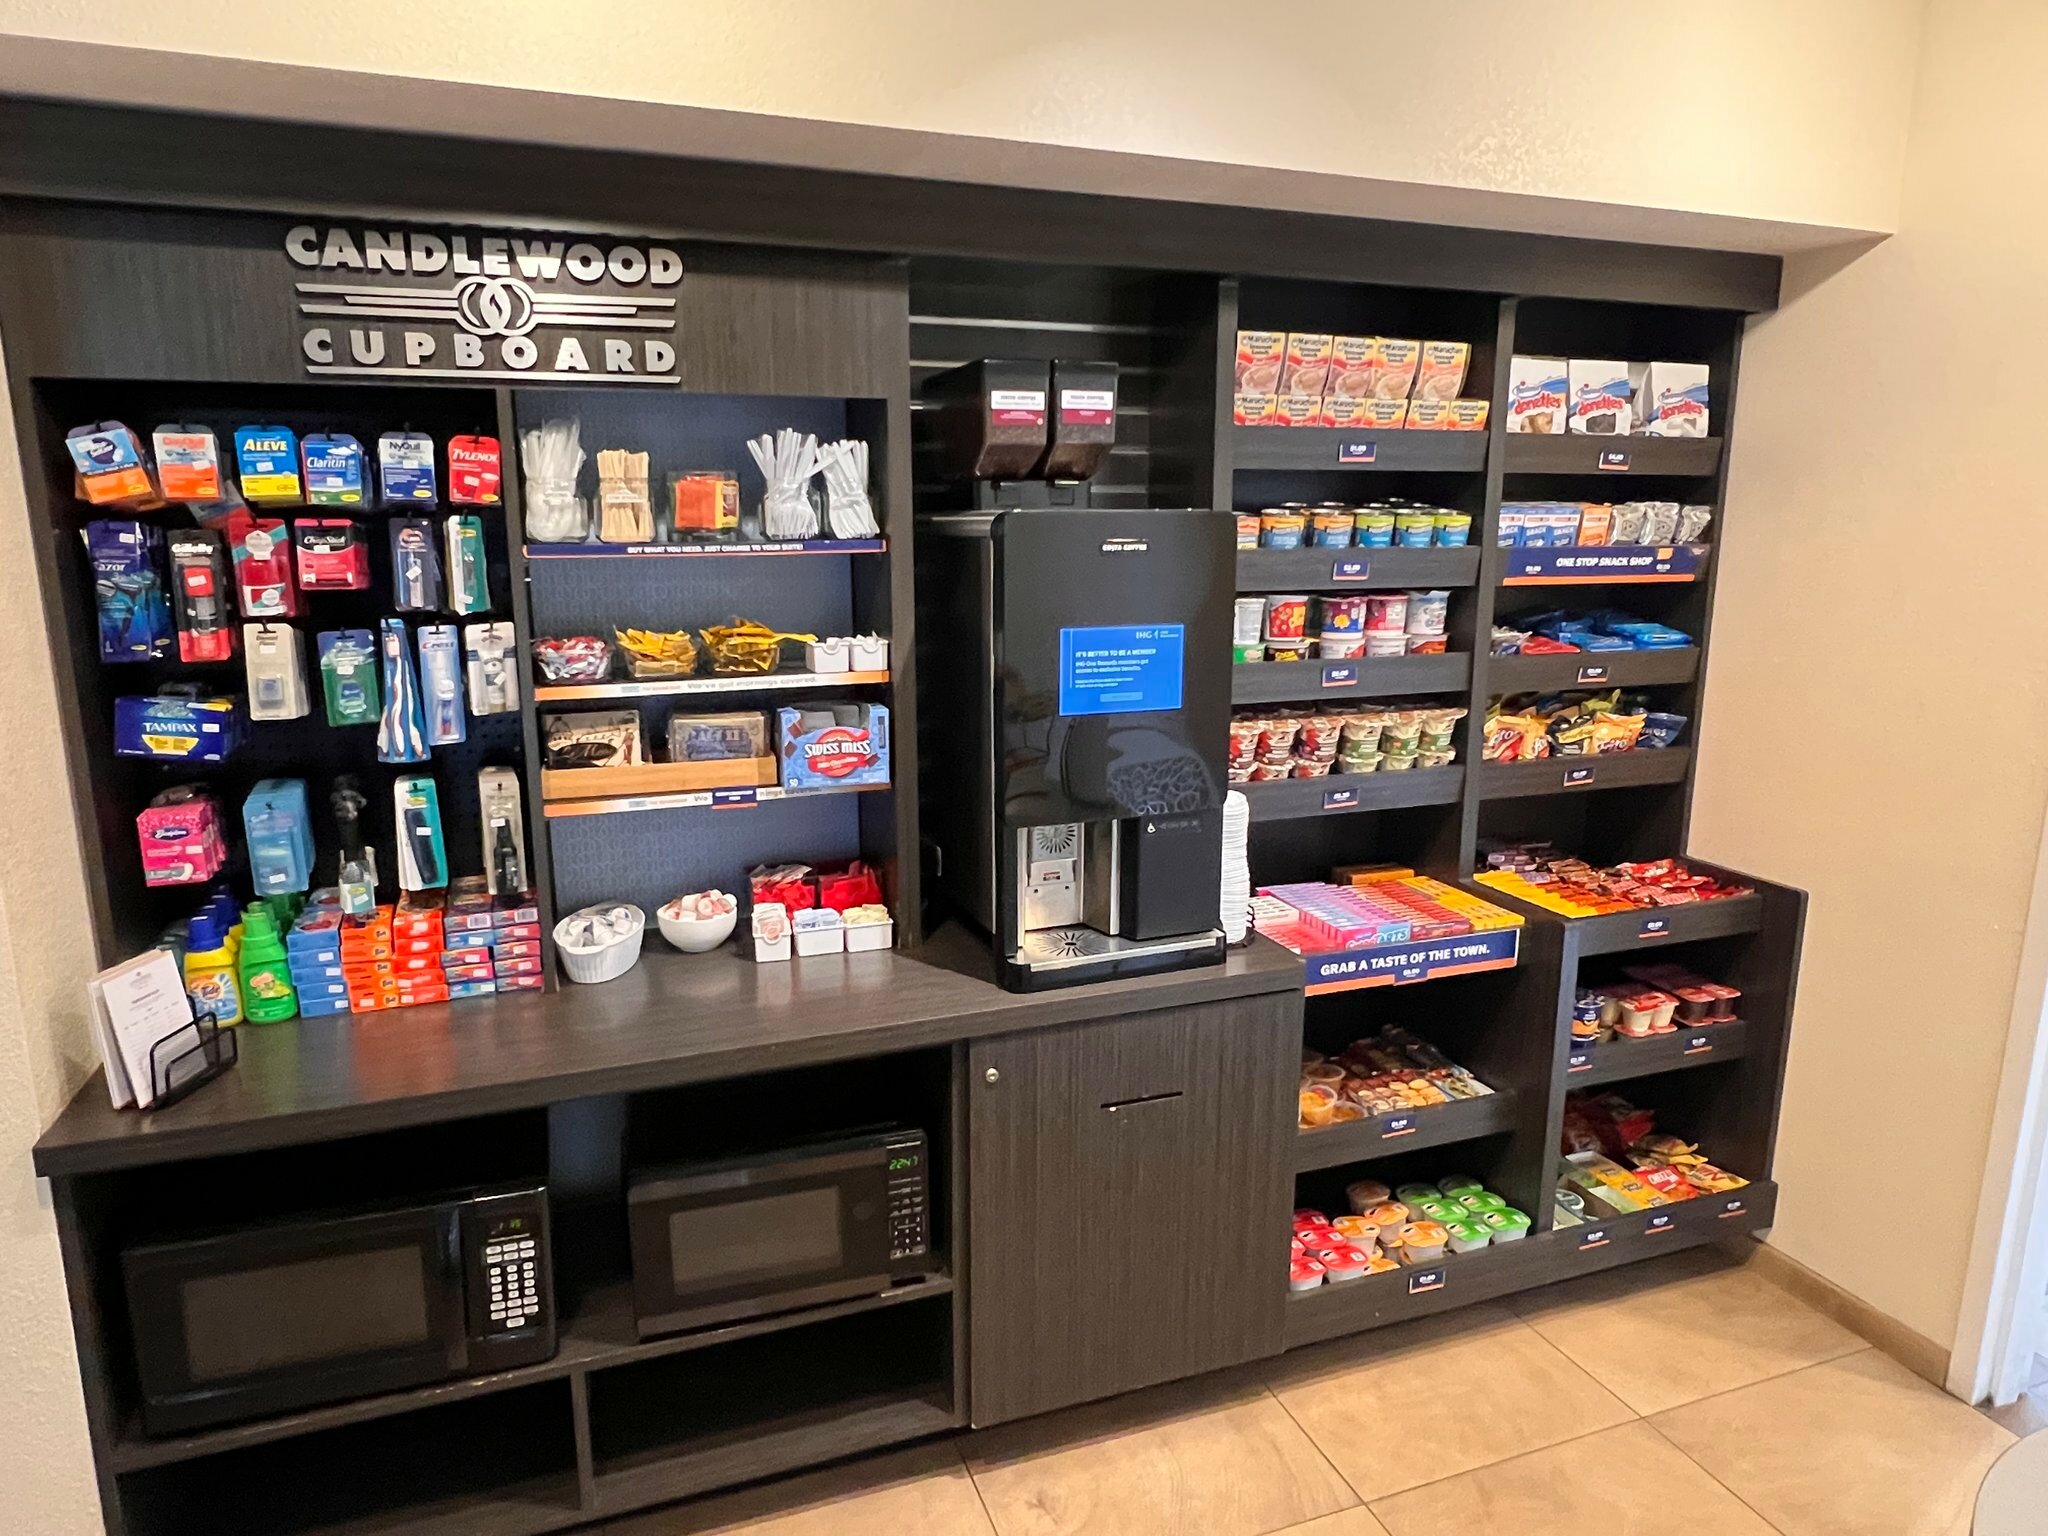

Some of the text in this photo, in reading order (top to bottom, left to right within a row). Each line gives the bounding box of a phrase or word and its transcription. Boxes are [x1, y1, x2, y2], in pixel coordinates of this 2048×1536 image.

[285, 225, 684, 285] CANDLEWOOD
[302, 328, 677, 372] CUPBOARD
[1515, 394, 1561, 415] donettes
[1578, 396, 1624, 416] donettes
[1660, 401, 1704, 420] donettes
[307, 457, 346, 469] Claritin
[452, 448, 499, 462] TYLENOL
[1556, 556, 1653, 567] ONE STOP SNACK SHOP
[142, 722, 197, 733] TAMPAX
[804, 740, 871, 758] SWISS MISS
[1320, 944, 1491, 976] GRAB A TASTE OF THE TOWN.
